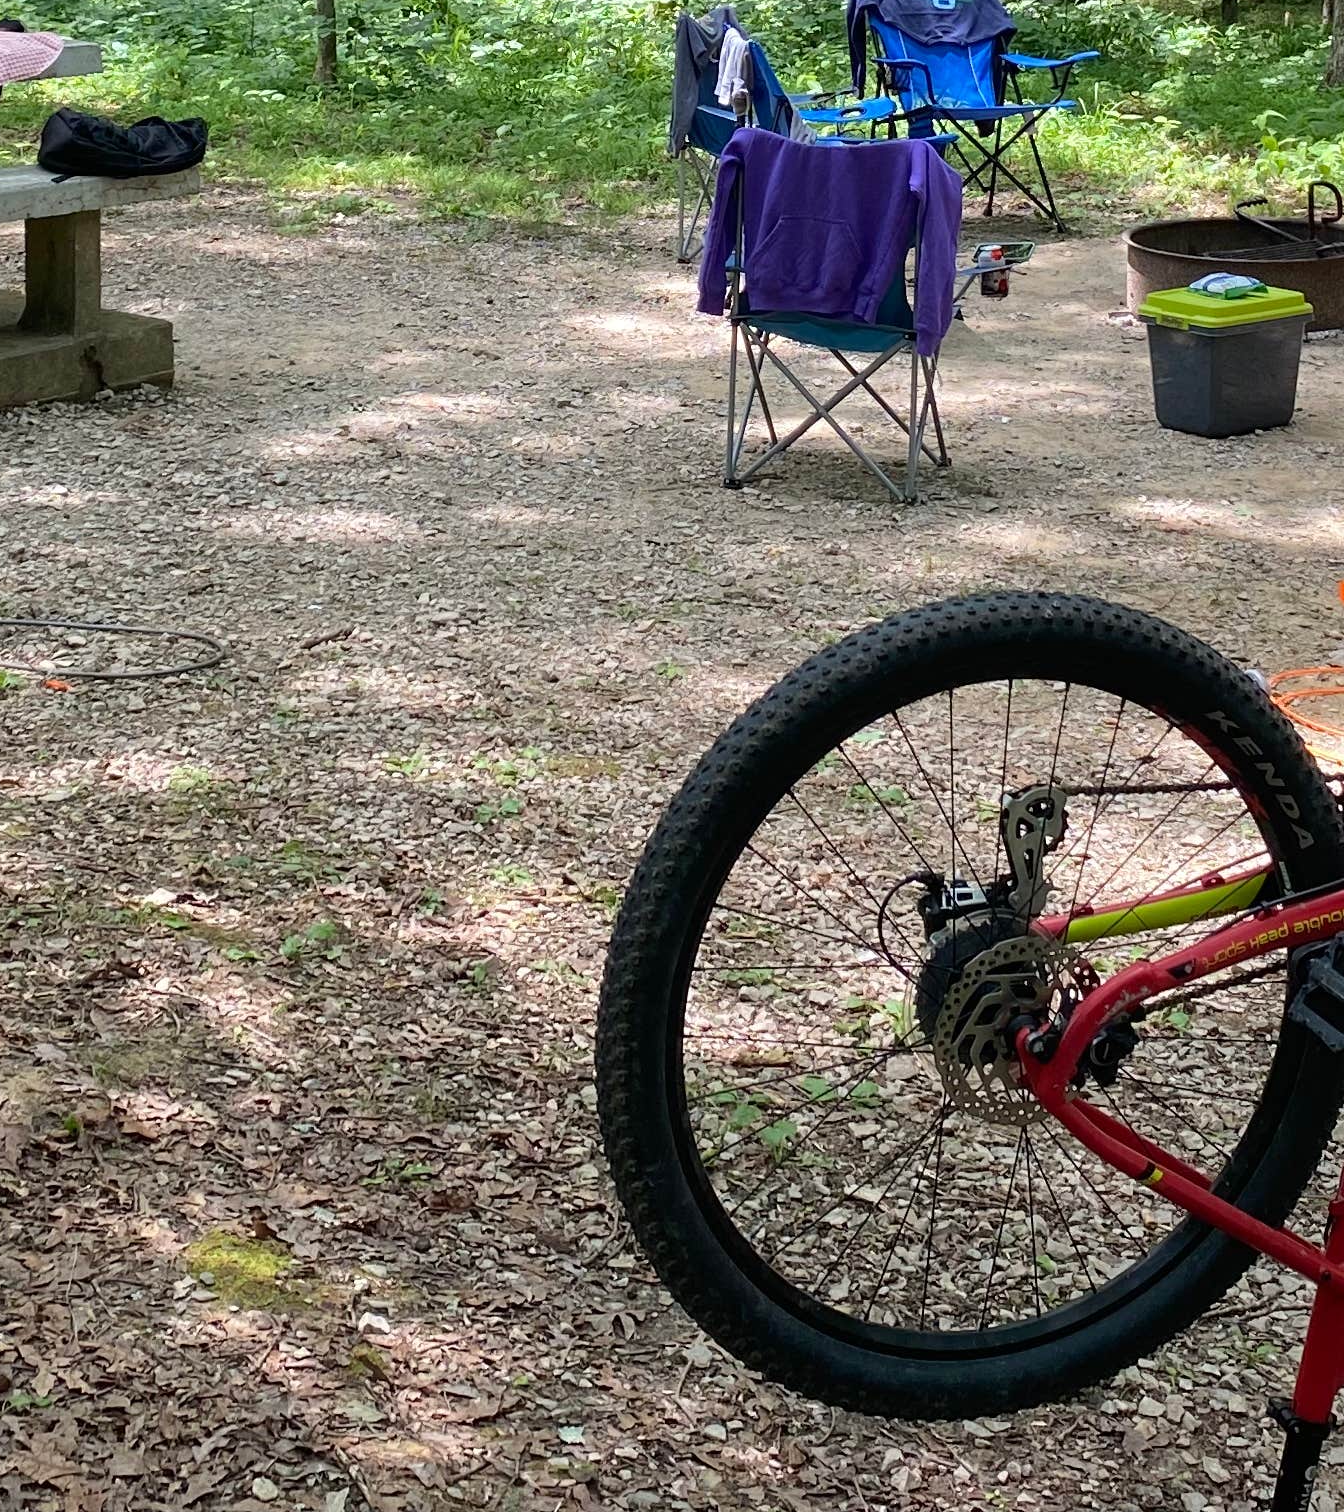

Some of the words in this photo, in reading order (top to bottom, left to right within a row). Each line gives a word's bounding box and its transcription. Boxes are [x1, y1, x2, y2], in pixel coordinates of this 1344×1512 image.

[1205, 710, 1315, 849] KENDA
[1249, 923, 1288, 950] peak
[1202, 942, 1247, 968] sport
